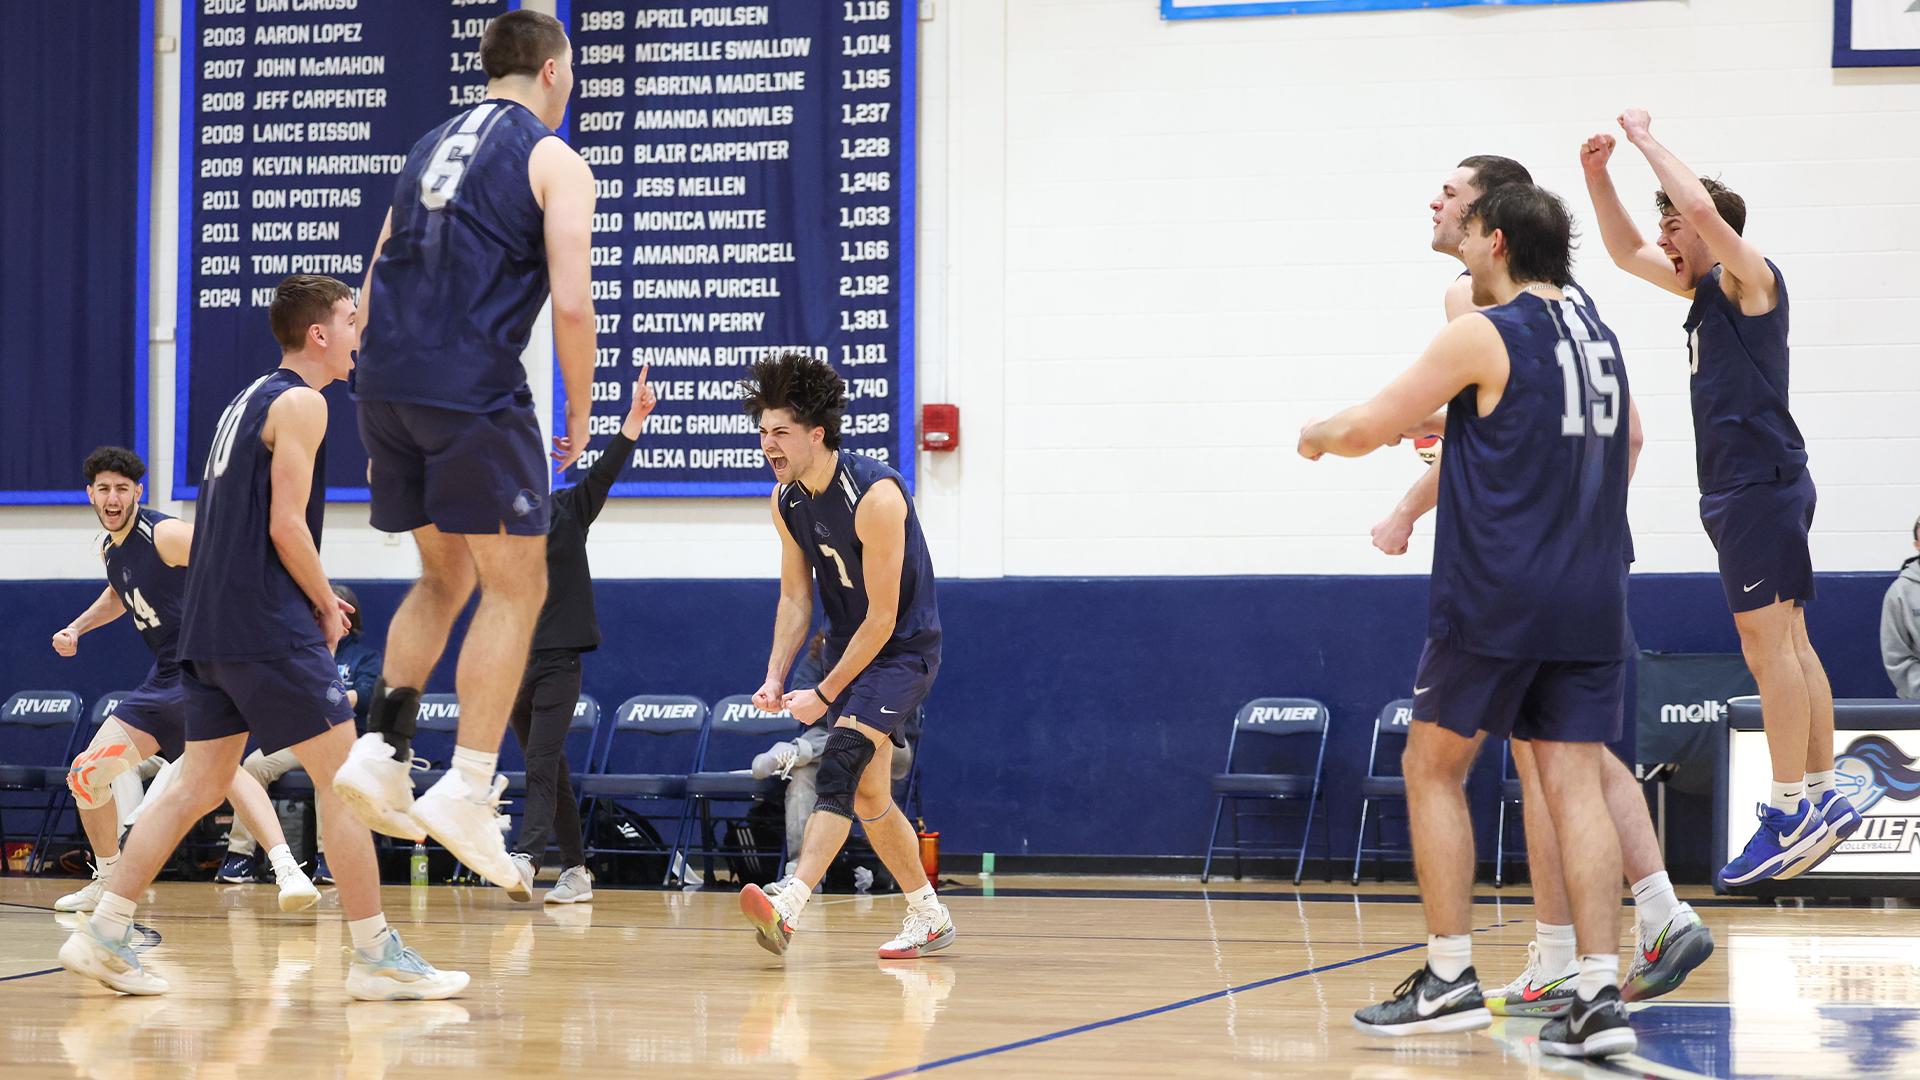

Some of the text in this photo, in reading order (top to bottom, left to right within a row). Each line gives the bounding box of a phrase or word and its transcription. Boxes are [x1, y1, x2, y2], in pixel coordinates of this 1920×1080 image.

[582, 6, 768, 31] 1993 APRIL POULSEN
[844, 1, 889, 23] 1,116
[204, 23, 362, 46] 2003 AARON LOPEZ
[450, 17, 494, 41] 1,01
[581, 38, 811, 64] 1994 MICHELLE SWALLOW
[843, 35, 891, 57] 1,014
[204, 56, 384, 79] 2007 JOHN McMAHON
[450, 51, 483, 74] 1,73
[581, 71, 805, 98] 1998 SABRINA MADELINE
[843, 69, 890, 91] 1,195
[203, 89, 386, 111] 2008 JEFF CARPENTER
[449, 84, 489, 107] 1,53
[580, 106, 793, 131] 2007 AMANDA KNOWLES
[842, 103, 890, 125] 1,237
[202, 122, 370, 144] 2009 LANCE BISSON
[580, 140, 789, 167] 2010 BLAIR CARPENTER
[841, 138, 890, 160] 1,228
[201, 158, 243, 177] 2009
[253, 157, 302, 175] KEVIN
[419, 131, 481, 211] 6
[595, 176, 745, 200] 010 JESS MELLEN
[840, 172, 890, 194] 1,246
[203, 189, 360, 210] 2011 DON POITRAS
[590, 210, 766, 234] 010 MONICA WHITE
[840, 206, 890, 228] 1,033
[203, 222, 339, 242] 2011 NICK BEAN
[590, 243, 795, 268] 012 AMANDRA PURCELL
[841, 241, 889, 263] 1,166
[201, 254, 363, 275] 2014 TOM POITRAS
[590, 278, 780, 301] 015 DEANNA PURCELL
[840, 275, 889, 297] 2,192
[200, 289, 240, 307] 2024
[594, 312, 765, 335] 017 CAITLYN PERRY
[841, 310, 889, 332] 1,381
[631, 345, 713, 368] SAVANNA
[842, 344, 887, 366] 1,181
[591, 381, 622, 402] 019
[1554, 338, 1622, 437] 15
[588, 413, 760, 436] 025 YRIC GRUMBL
[839, 412, 891, 438] 2,523
[632, 449, 686, 468] ALEXA
[689, 447, 766, 470] DUFRIES
[11, 698, 71, 716] RIVIER
[627, 703, 698, 722] RIVIER
[1248, 706, 1318, 724] RIVIER
[1660, 700, 1728, 723] molt
[1839, 842, 1893, 850] VOLLEYBALL
